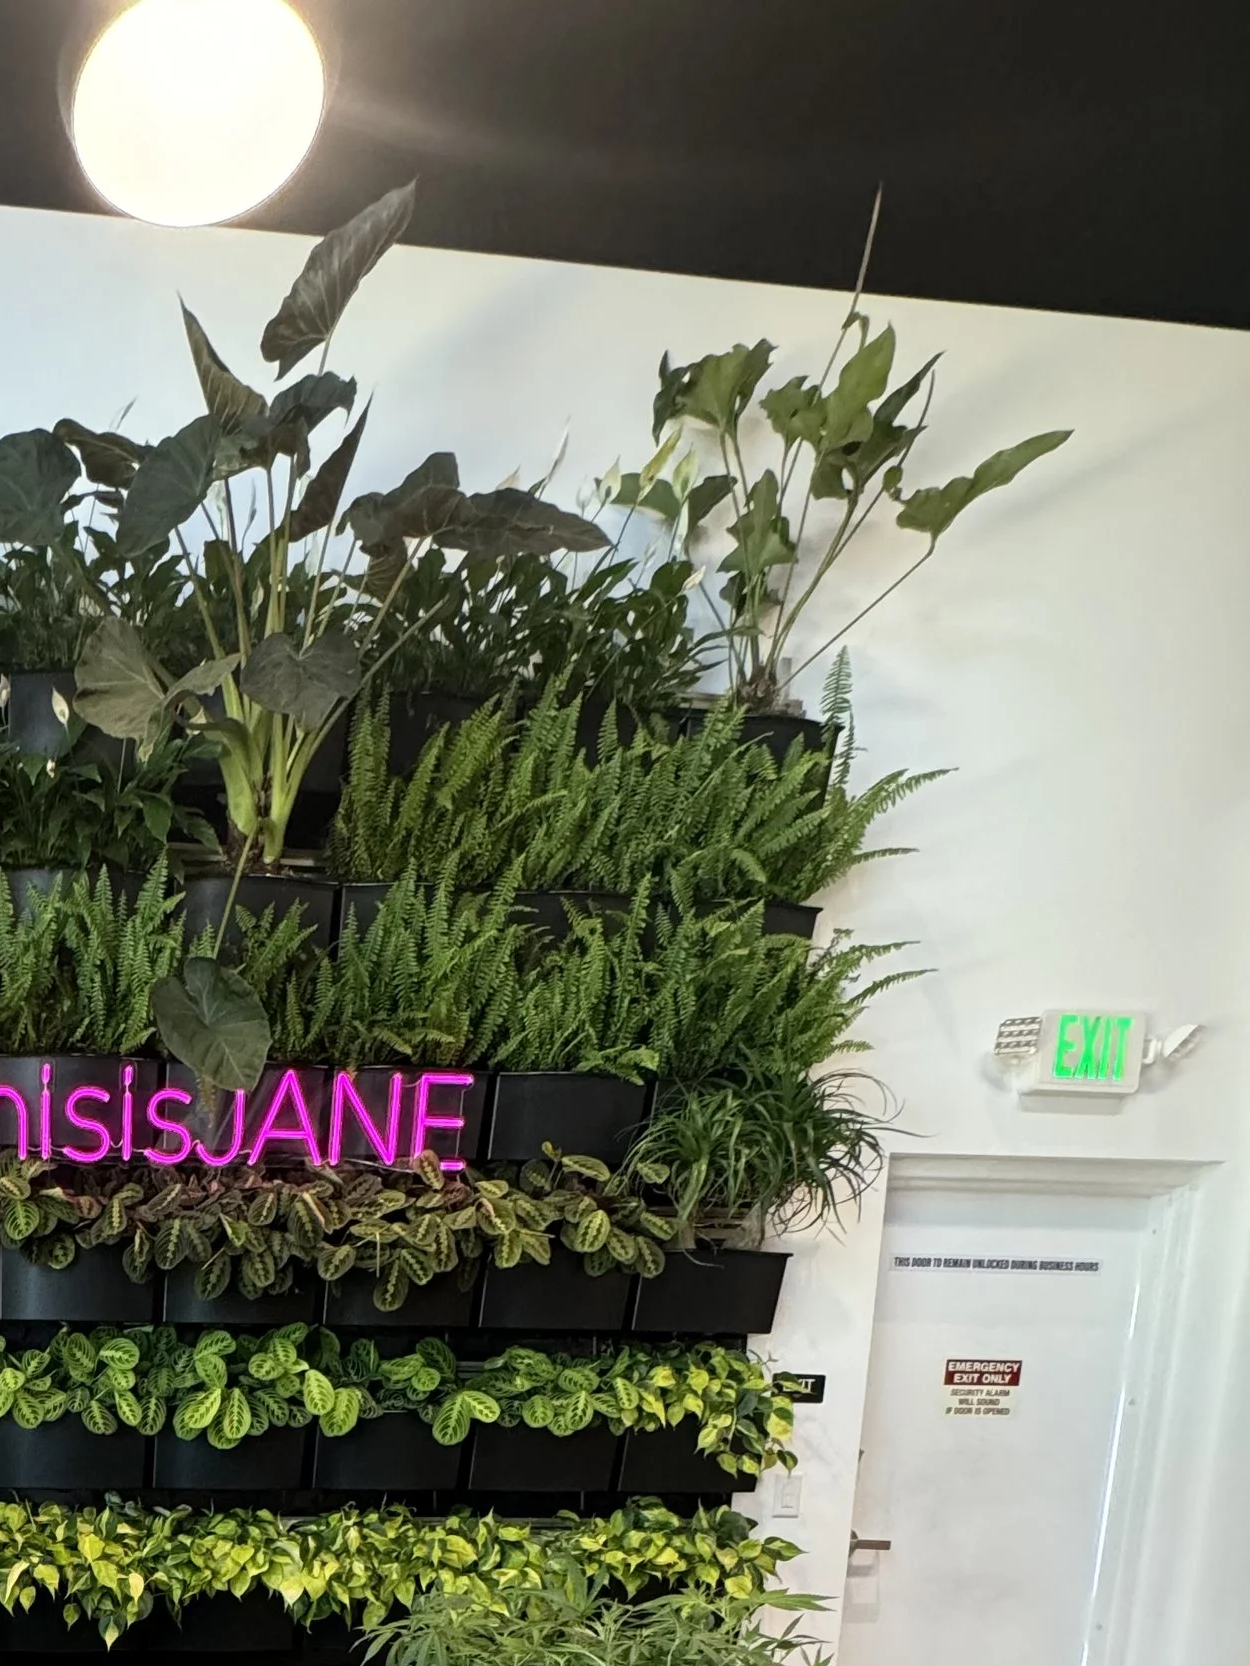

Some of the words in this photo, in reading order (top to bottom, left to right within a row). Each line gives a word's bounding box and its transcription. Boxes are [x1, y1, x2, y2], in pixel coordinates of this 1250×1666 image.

[1053, 1013, 1133, 1081] EXIT
[894, 1256, 910, 1267] THIS
[911, 1257, 932, 1268] DOOR
[933, 1257, 942, 1268] TO
[943, 1258, 971, 1269] REMAIN
[972, 1258, 1010, 1270] UNLOCKED
[1010, 1259, 1038, 1271] DURING
[1039, 1260, 1074, 1272] BUSINESS
[1074, 1261, 1099, 1273] HOURS
[947, 1361, 1020, 1373] EMERGENCY
[953, 1373, 980, 1384] EXIT
[981, 1373, 1012, 1384] ONLY
[950, 1388, 984, 1397] SECURITY
[984, 1389, 1010, 1397] ALARM
[958, 1398, 974, 1406] WILL
[976, 1398, 1000, 1406] SOUND
[945, 1406, 953, 1414] IF
[953, 1407, 973, 1415] DOOR
[974, 1407, 981, 1415] IS
[982, 1407, 1011, 1416] OPENED
